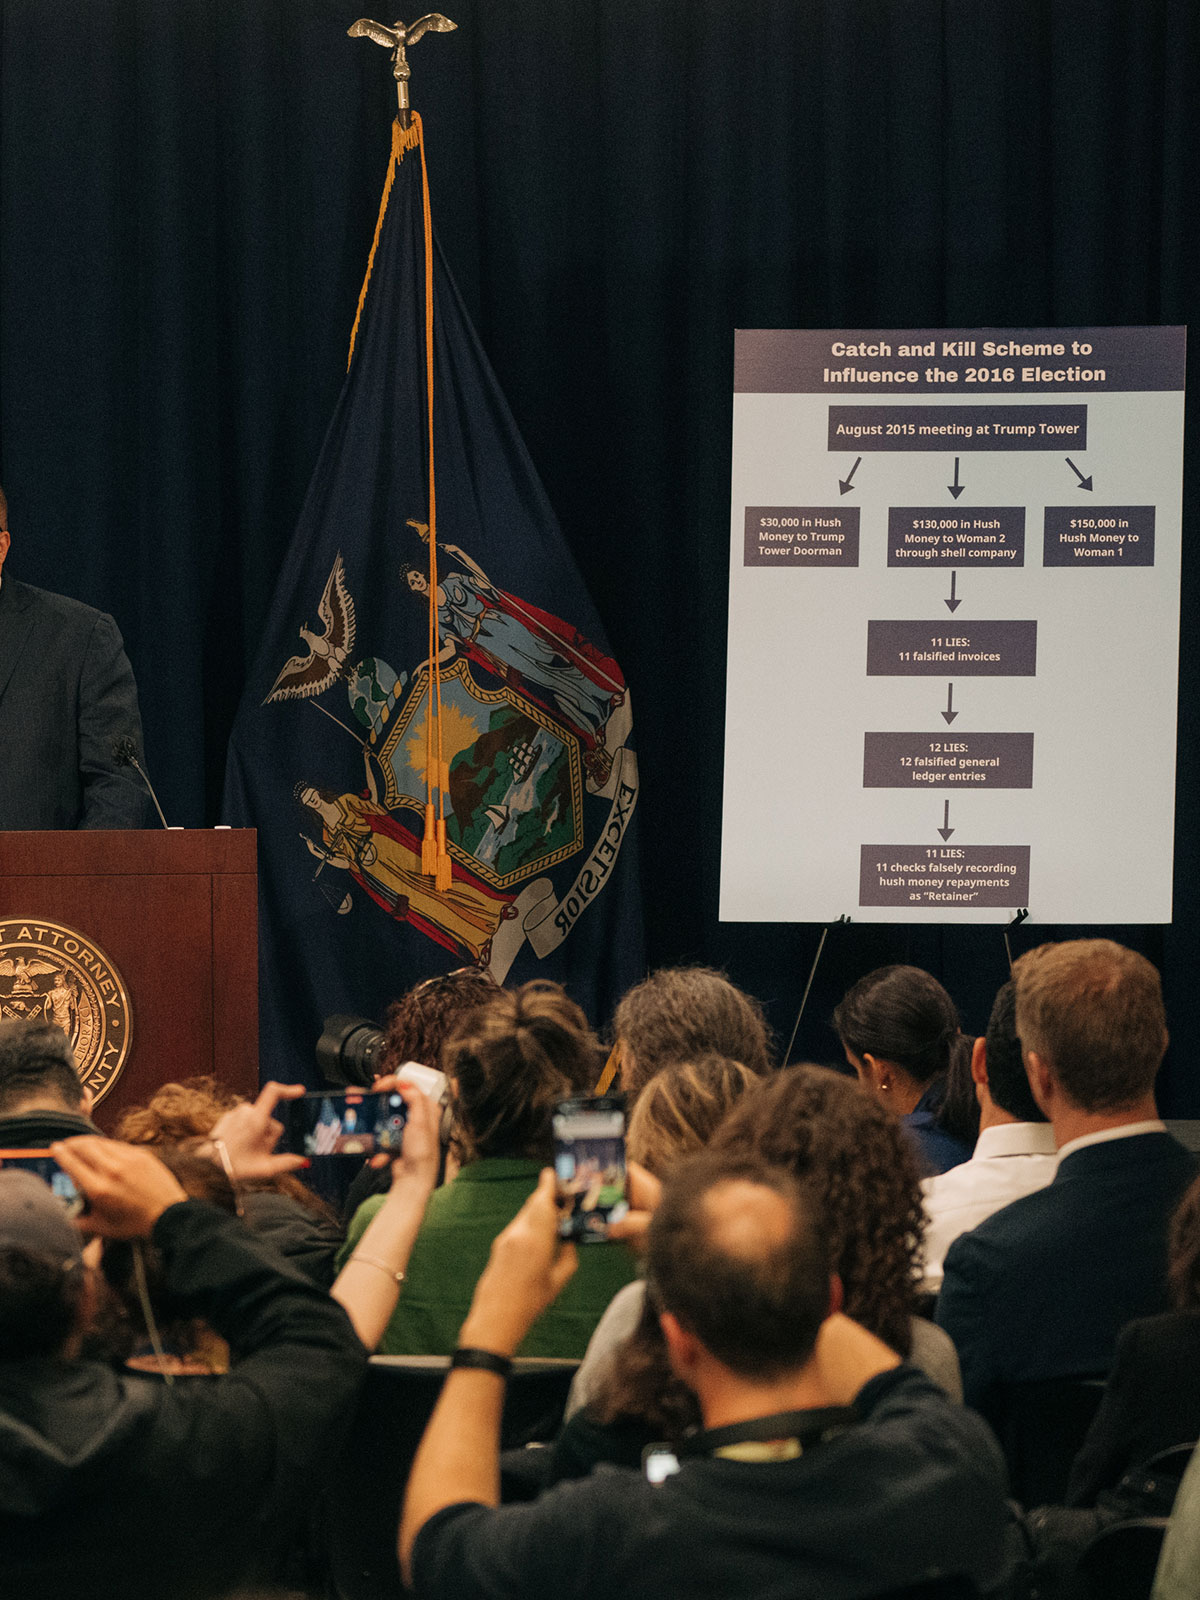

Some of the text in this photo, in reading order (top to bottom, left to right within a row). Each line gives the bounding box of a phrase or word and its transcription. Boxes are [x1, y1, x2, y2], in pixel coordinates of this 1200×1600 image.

[831, 341, 1093, 357] Catch and Kill Scheme to
[823, 366, 1106, 383] Influence the 2016 Election
[835, 423, 1080, 438] August 2015 meeting at Trump Tower
[760, 517, 842, 528] $30,000 in Hush
[912, 519, 1001, 530] $130,000 in Hush
[1070, 518, 1129, 529] $150,000 in
[758, 532, 845, 544] Money to Trump
[904, 533, 1006, 546] Money to Woman 2
[1059, 533, 1139, 545] Hush Money to
[758, 546, 842, 556] Tower Doorman
[895, 548, 1017, 560] through shell company
[1073, 547, 1123, 557] Woman 1
[931, 637, 970, 647] 11 LIES:
[899, 651, 1001, 661] 11 falsified invoices
[929, 743, 969, 752] 12 LIES:
[900, 756, 1000, 769] 12 falsified general
[912, 771, 986, 783] ledger entries
[926, 849, 965, 858] 11 LIES:
[876, 862, 1017, 875] 11 checks falsely recording
[879, 876, 1010, 889] hush money repayments
[909, 893, 922, 901] as
[17, 926, 121, 1008] ATTORNEY
[87, 1040, 119, 1090] NTY
